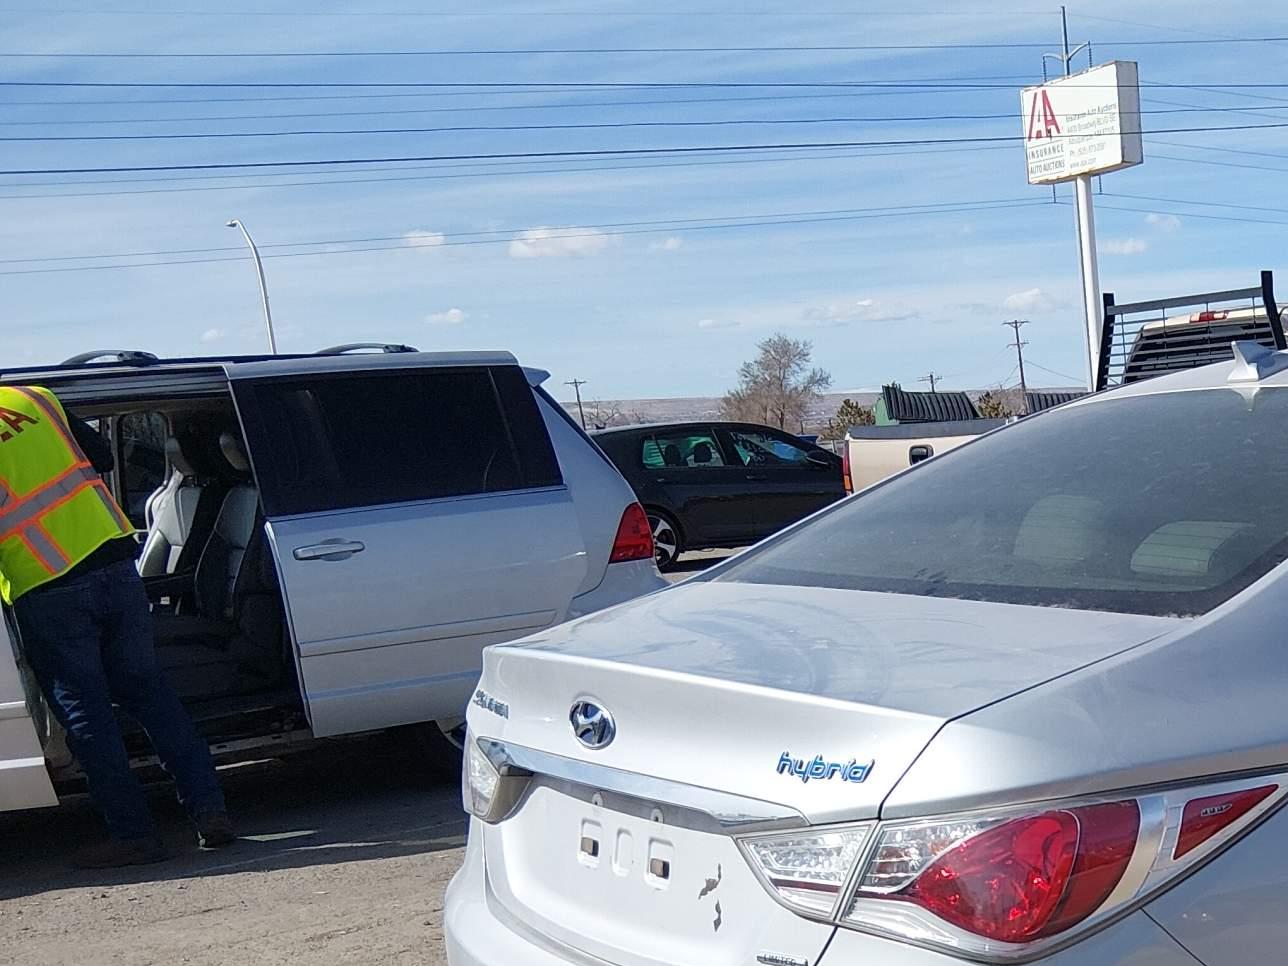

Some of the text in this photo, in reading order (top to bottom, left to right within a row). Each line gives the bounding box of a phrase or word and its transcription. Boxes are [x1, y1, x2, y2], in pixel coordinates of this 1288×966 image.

[1028, 143, 1065, 161] INSURANCE
[1030, 163, 1043, 175] AUTO
[1043, 159, 1066, 172] AUCTIONS
[776, 750, 876, 784] hybrid
